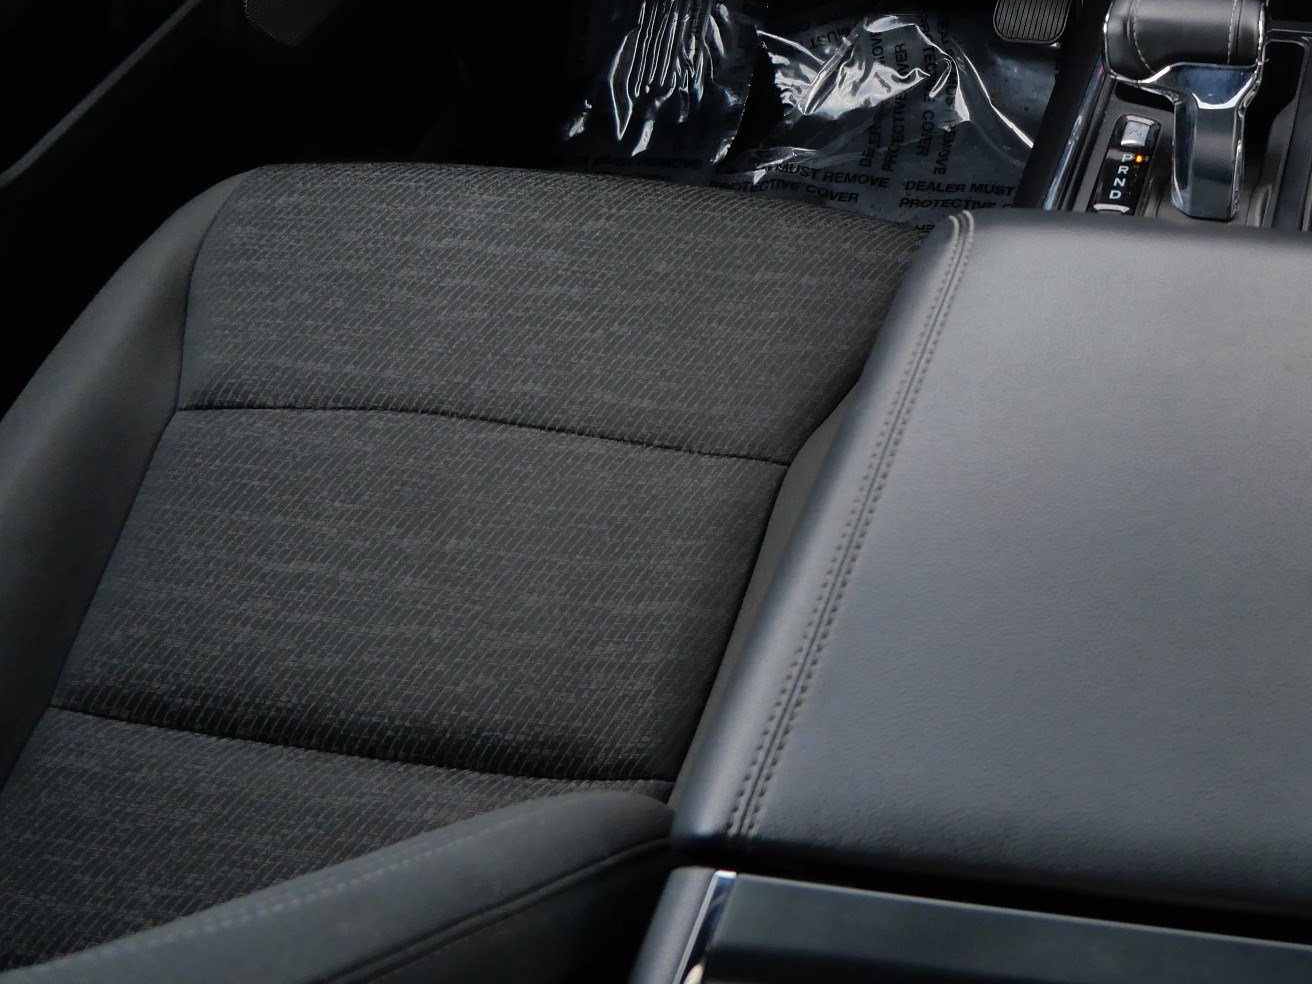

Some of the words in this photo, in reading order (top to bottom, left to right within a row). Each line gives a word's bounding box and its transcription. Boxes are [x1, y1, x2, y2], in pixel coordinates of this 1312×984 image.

[1121, 153, 1133, 163] P
[1117, 165, 1130, 175] R
[823, 170, 890, 189] REMOVE
[1113, 177, 1126, 187] N
[805, 183, 859, 204] COVER
[904, 180, 966, 195] DEALER
[969, 184, 1016, 197] MUST
[1109, 189, 1122, 200] D
[900, 197, 997, 209] PROTECTIVE
